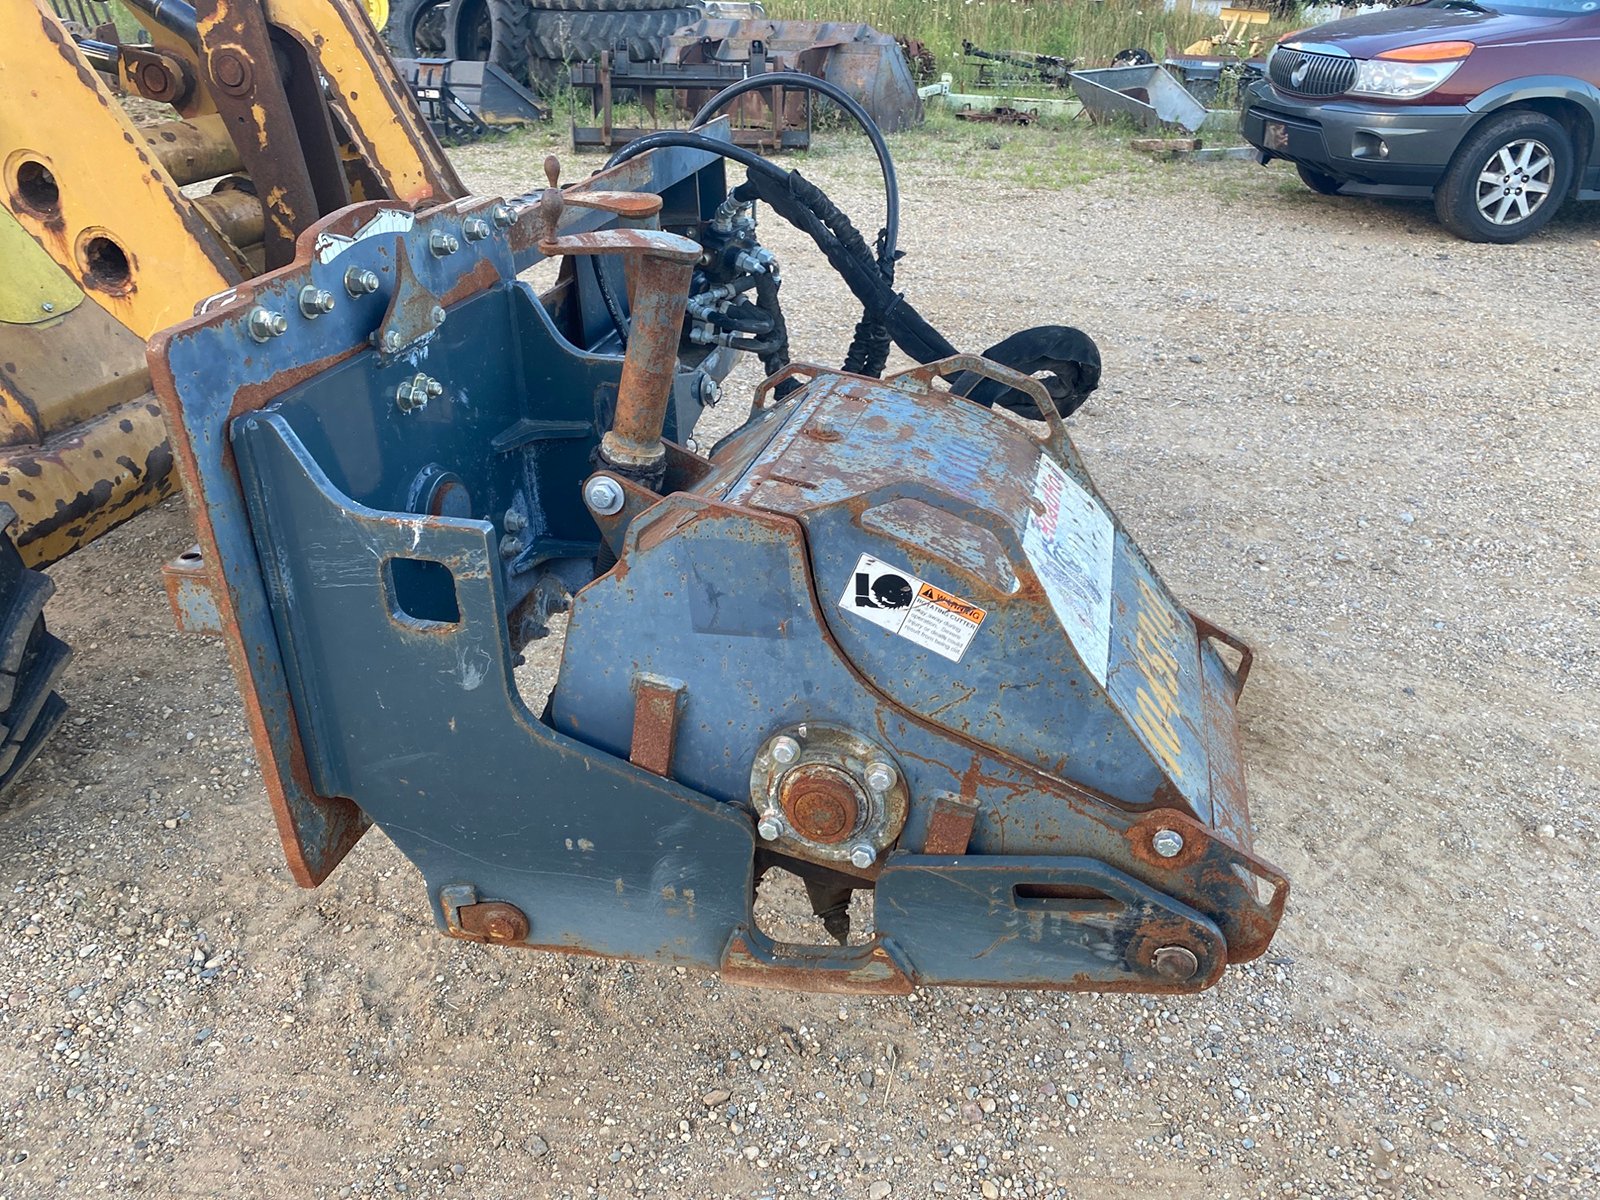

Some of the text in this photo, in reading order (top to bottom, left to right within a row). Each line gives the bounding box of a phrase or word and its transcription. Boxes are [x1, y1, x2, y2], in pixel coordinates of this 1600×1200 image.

[942, 620, 961, 633] during
[949, 614, 975, 629] CUTTER
[920, 632, 933, 641] from
[934, 638, 950, 649] being
